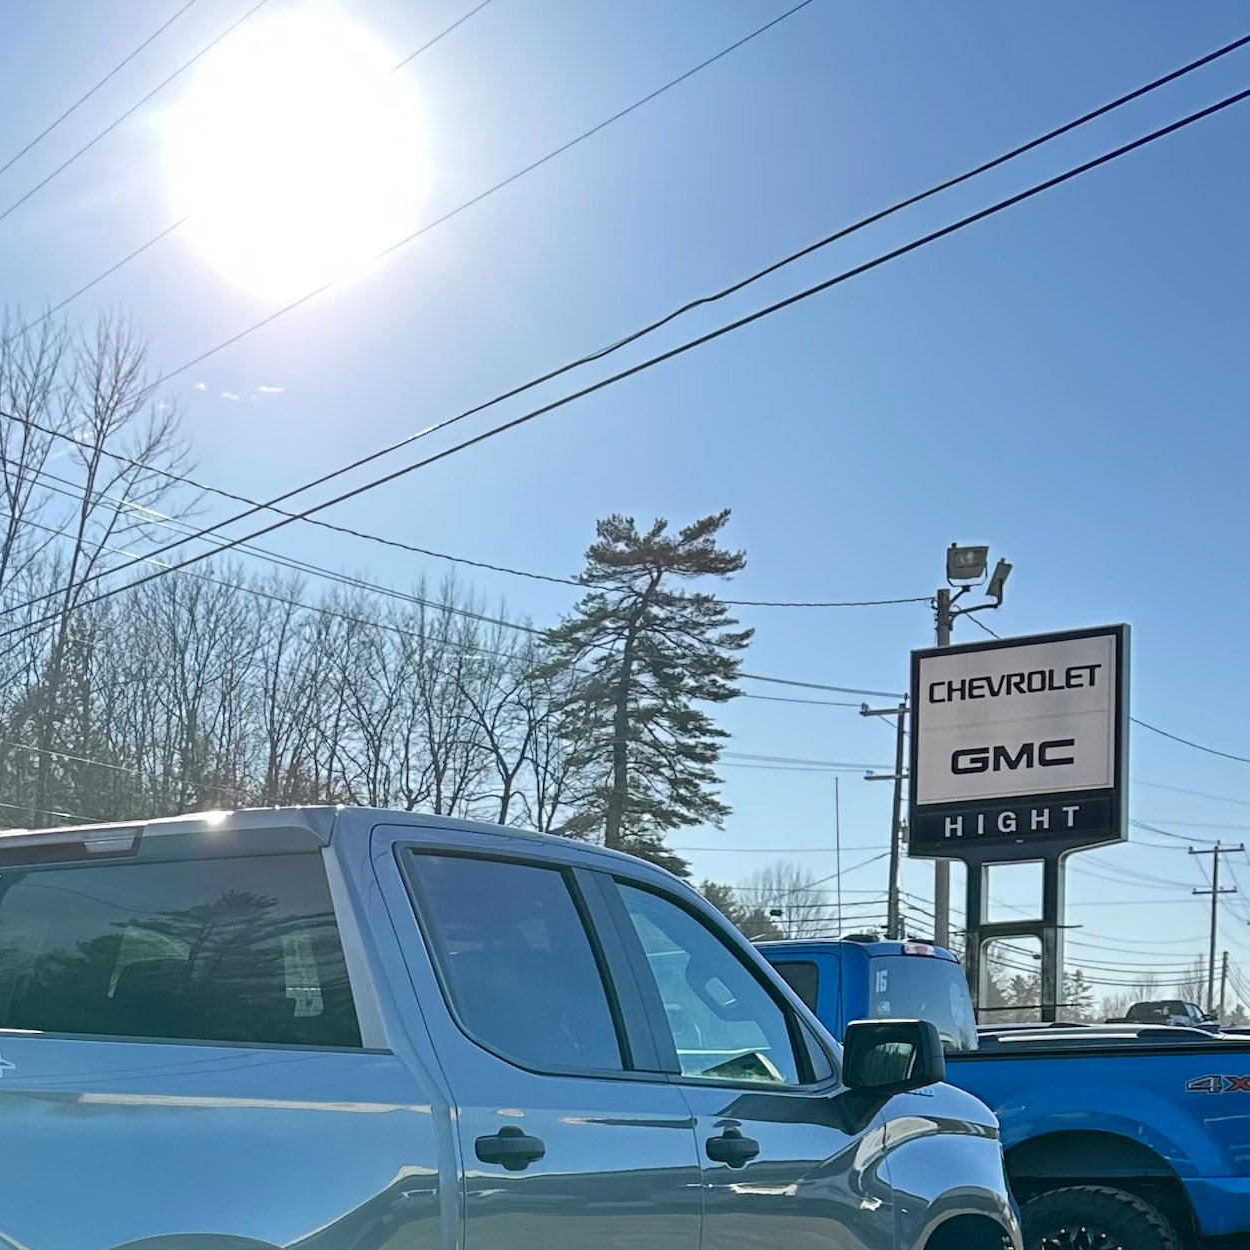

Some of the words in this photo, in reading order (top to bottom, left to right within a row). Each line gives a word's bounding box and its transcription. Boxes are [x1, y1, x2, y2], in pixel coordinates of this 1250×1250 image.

[929, 664, 1101, 703] CHEVROLET
[951, 738, 1075, 775] GMC
[945, 806, 1079, 838] HIGHT
[875, 969, 888, 993] 16
[1185, 1074, 1250, 1094] 4X
